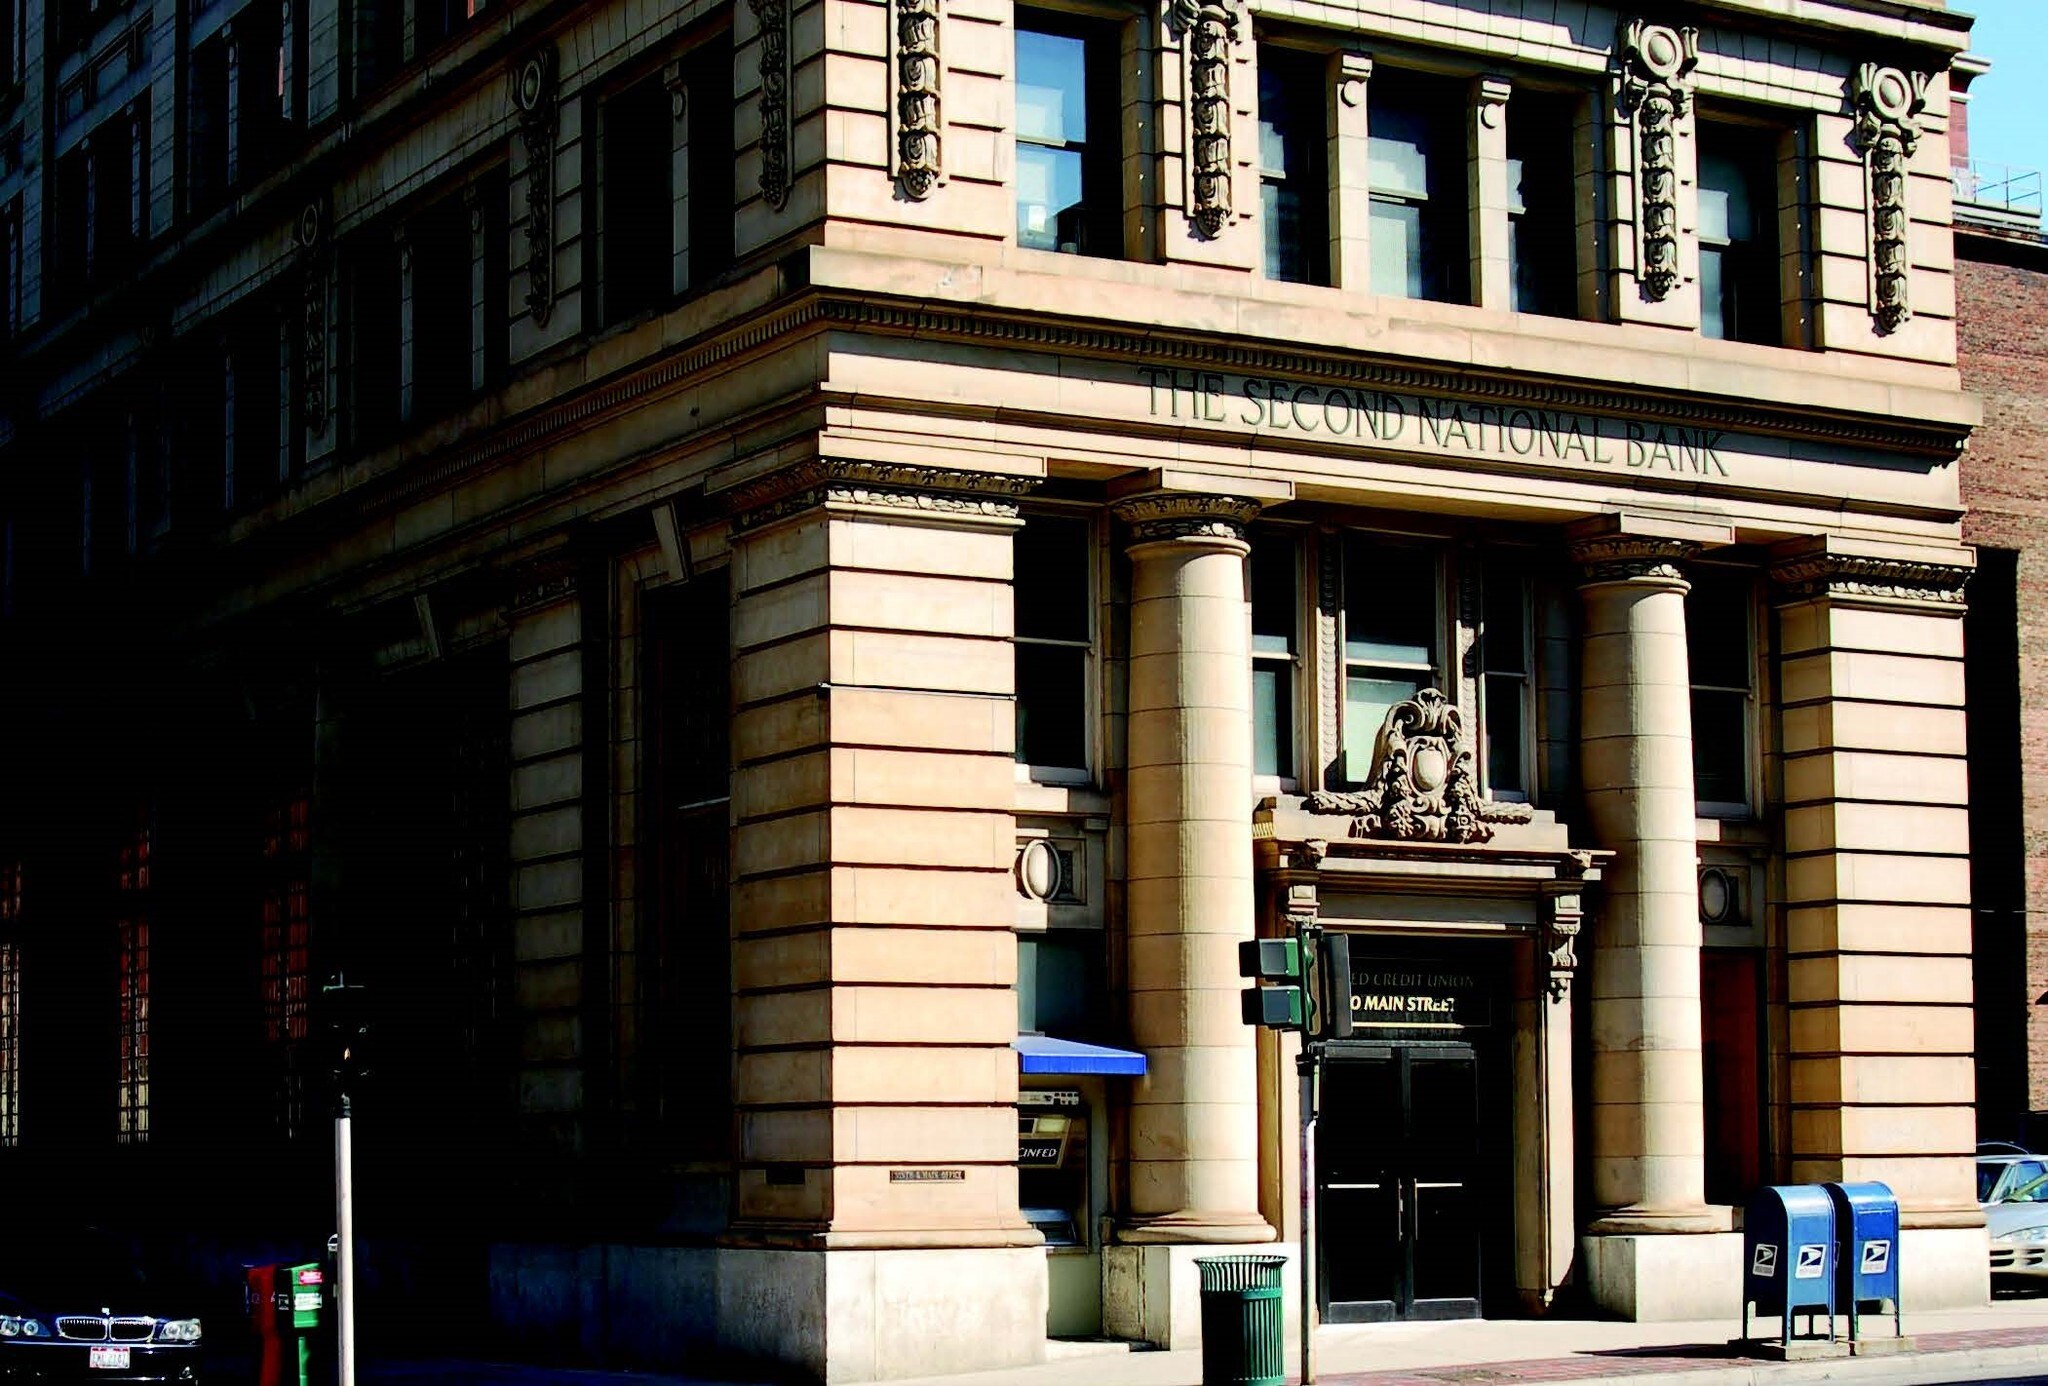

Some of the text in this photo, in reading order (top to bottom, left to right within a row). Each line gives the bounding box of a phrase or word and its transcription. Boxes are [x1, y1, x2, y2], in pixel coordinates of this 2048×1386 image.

[1138, 366, 1729, 477] THE SECOND NATIONAL BANK
[1351, 972, 1370, 986] ED
[1373, 972, 1422, 987] CREDIT
[1364, 995, 1404, 1012] MAIN
[1406, 996, 1455, 1013] STREET
